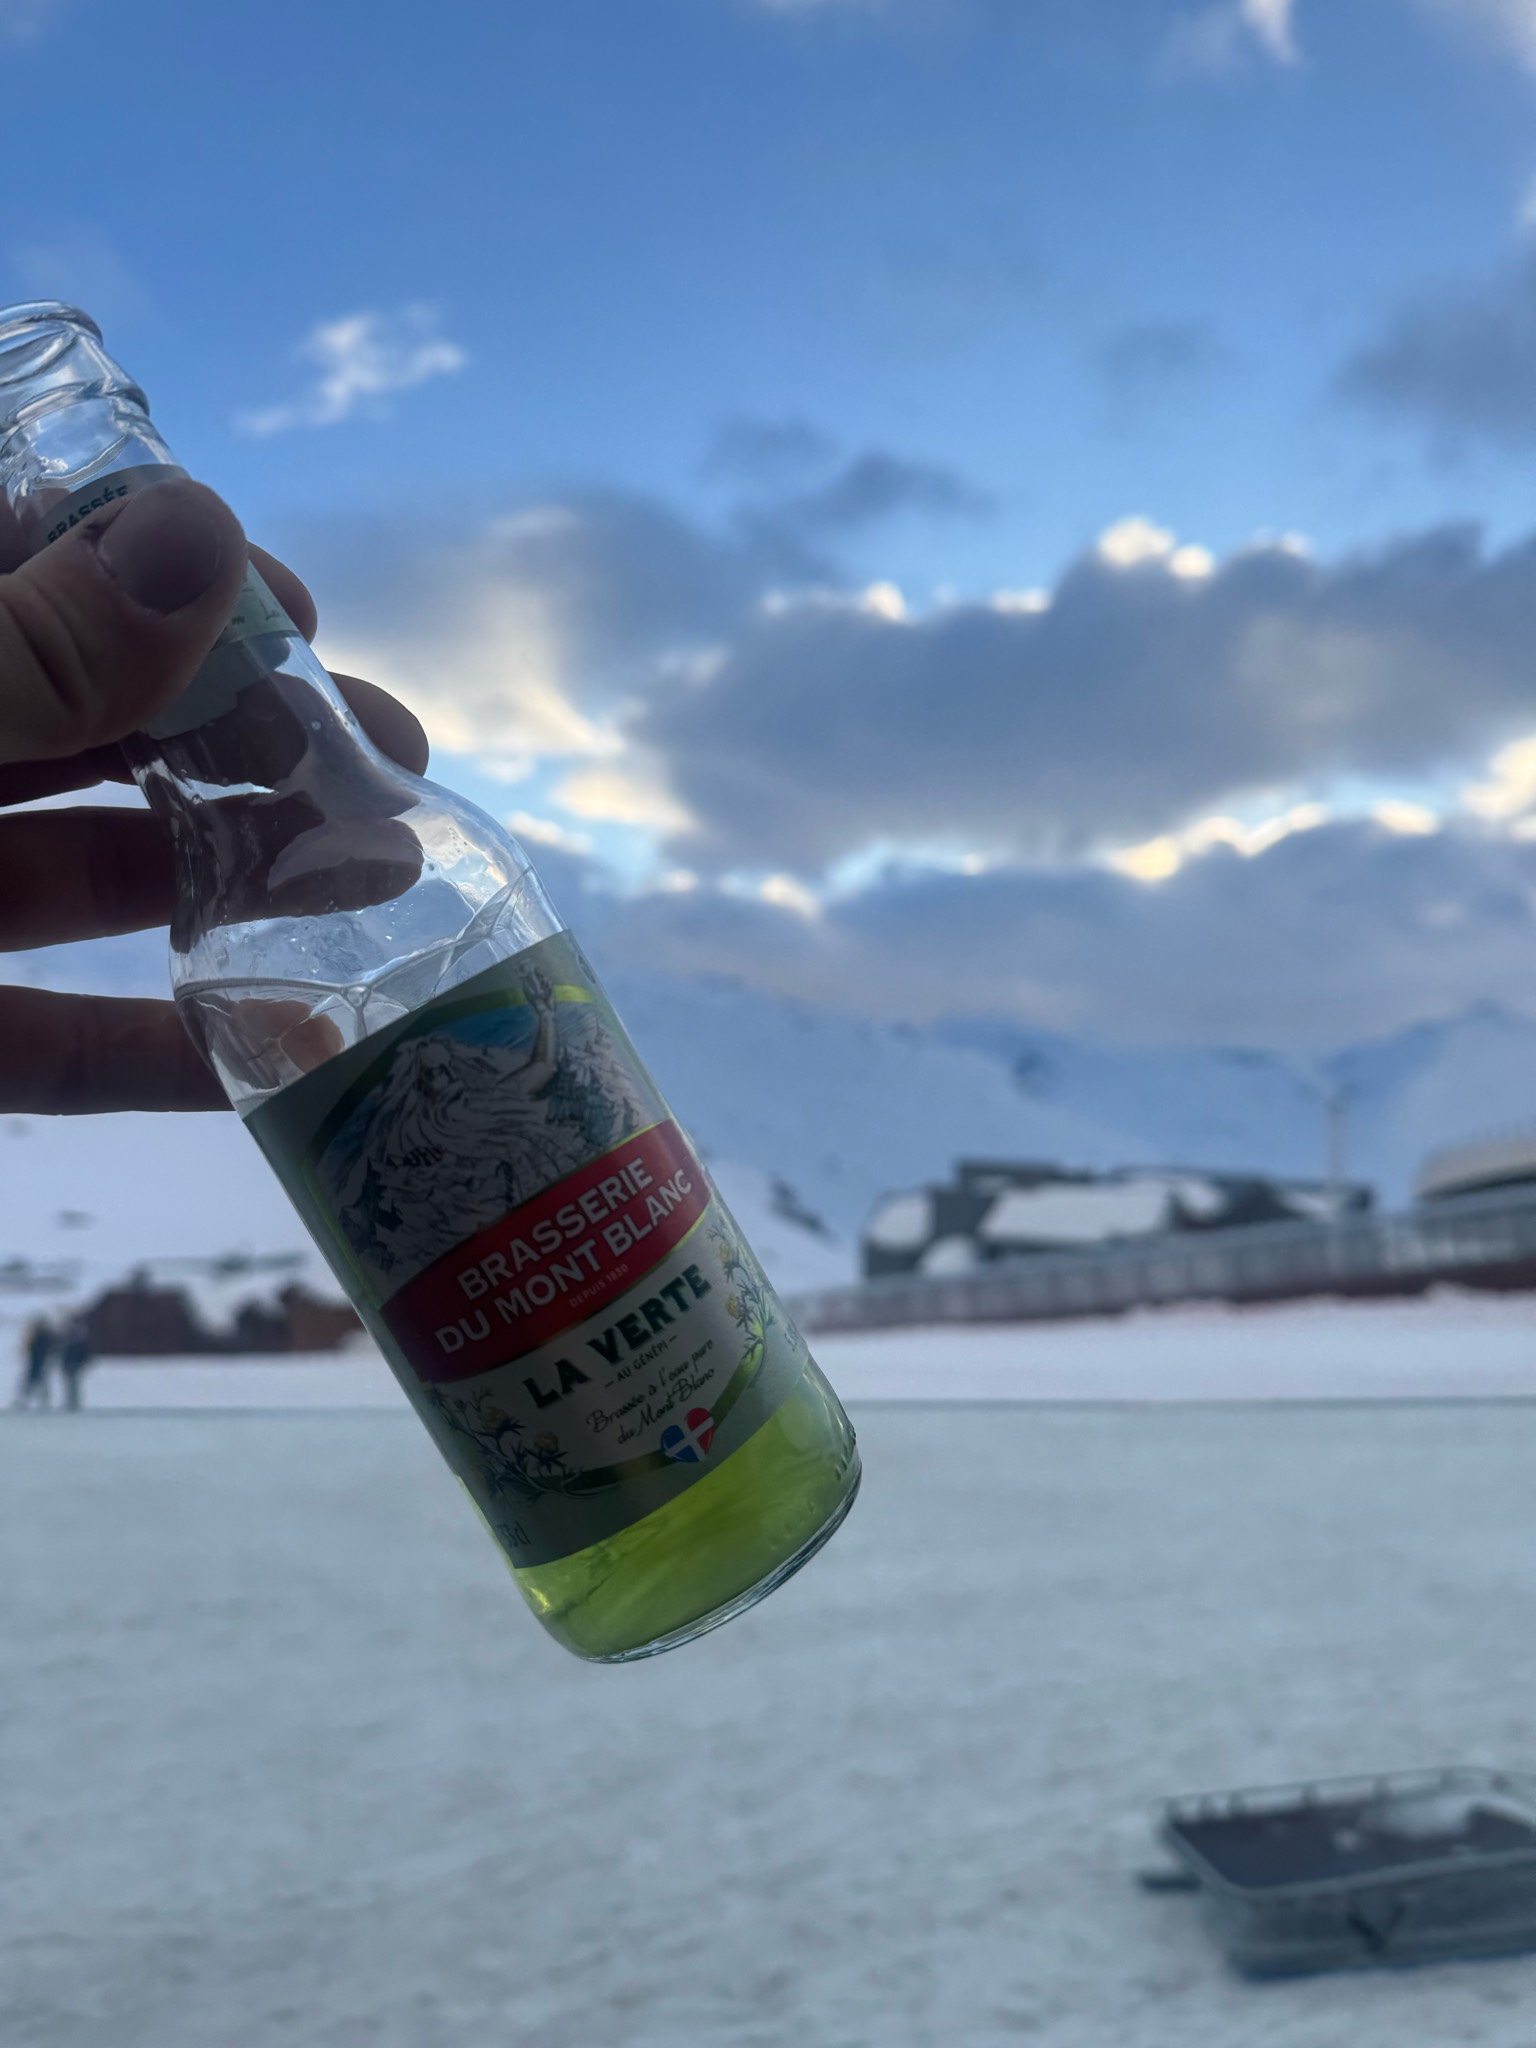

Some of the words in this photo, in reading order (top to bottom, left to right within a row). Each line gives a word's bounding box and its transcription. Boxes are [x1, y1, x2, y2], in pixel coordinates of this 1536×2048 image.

[434, 1311, 491, 1354] DU
[494, 1239, 602, 1325] MONT
[603, 1168, 692, 1257] BLANC
[457, 1158, 653, 1300] BRASSERIE
[569, 1280, 606, 1308] DEPUIS
[522, 1357, 593, 1409] LA
[586, 1263, 712, 1365] VERTE
[617, 1367, 632, 1383] AU
[633, 1341, 668, 1371] GÉNÉPI
